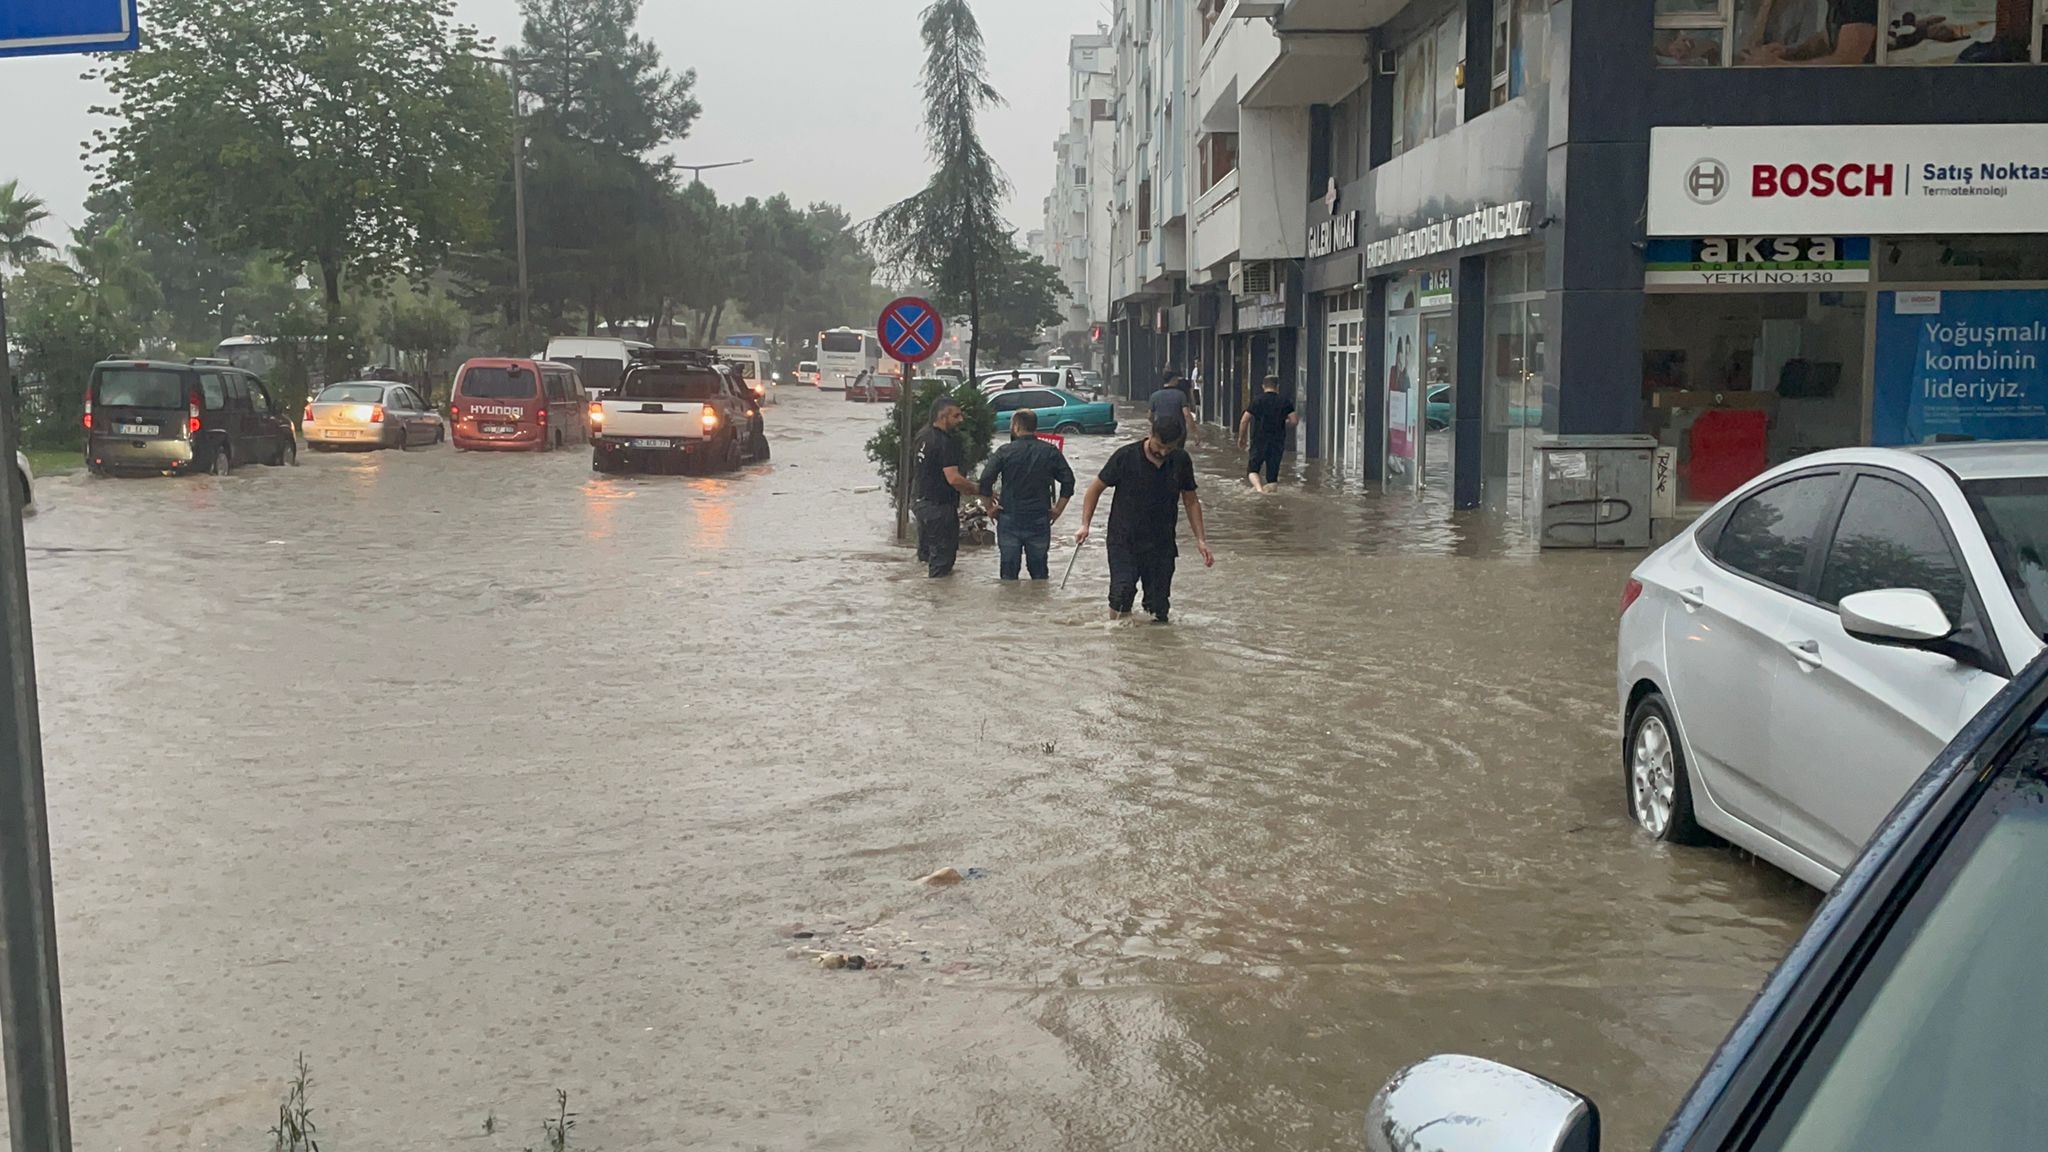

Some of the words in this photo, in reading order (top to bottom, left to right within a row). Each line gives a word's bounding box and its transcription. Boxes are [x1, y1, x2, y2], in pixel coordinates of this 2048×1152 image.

[1751, 163, 1894, 197] BOSCH
[1922, 163, 1973, 184] Satış
[1922, 186, 2008, 198] Termoteknoloji
[1456, 200, 1532, 248] DOĞALGAZ
[1700, 237, 1836, 262] aksa
[1702, 272, 1759, 284] YETKİ
[1925, 320, 2046, 347] Yoğuşmalı
[1925, 350, 2036, 370] kombinin
[1924, 378, 2026, 402] lideriyiz.
[470, 404, 523, 416] HYUNDAI
